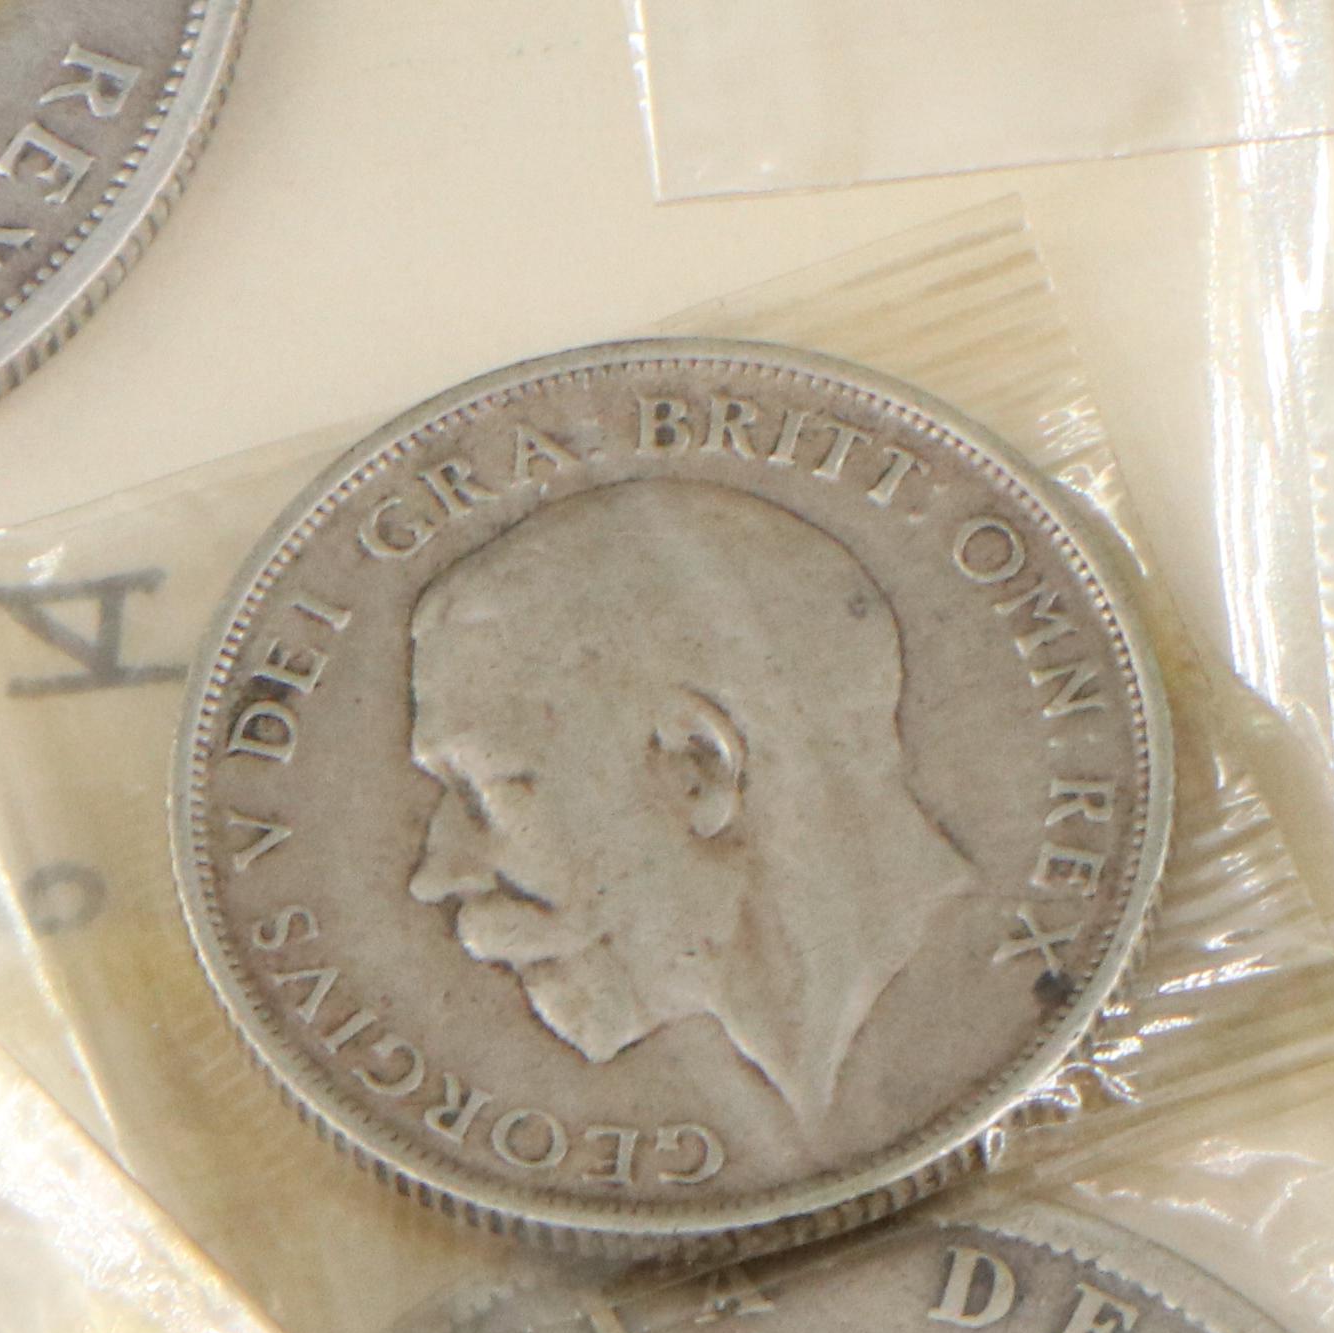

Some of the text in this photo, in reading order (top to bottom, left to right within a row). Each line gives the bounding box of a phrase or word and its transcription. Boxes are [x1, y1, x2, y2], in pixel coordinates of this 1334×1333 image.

[227, 596, 354, 764] DEI
[992, 777, 1116, 982] REX
[251, 903, 728, 1187] GEORGIVS
